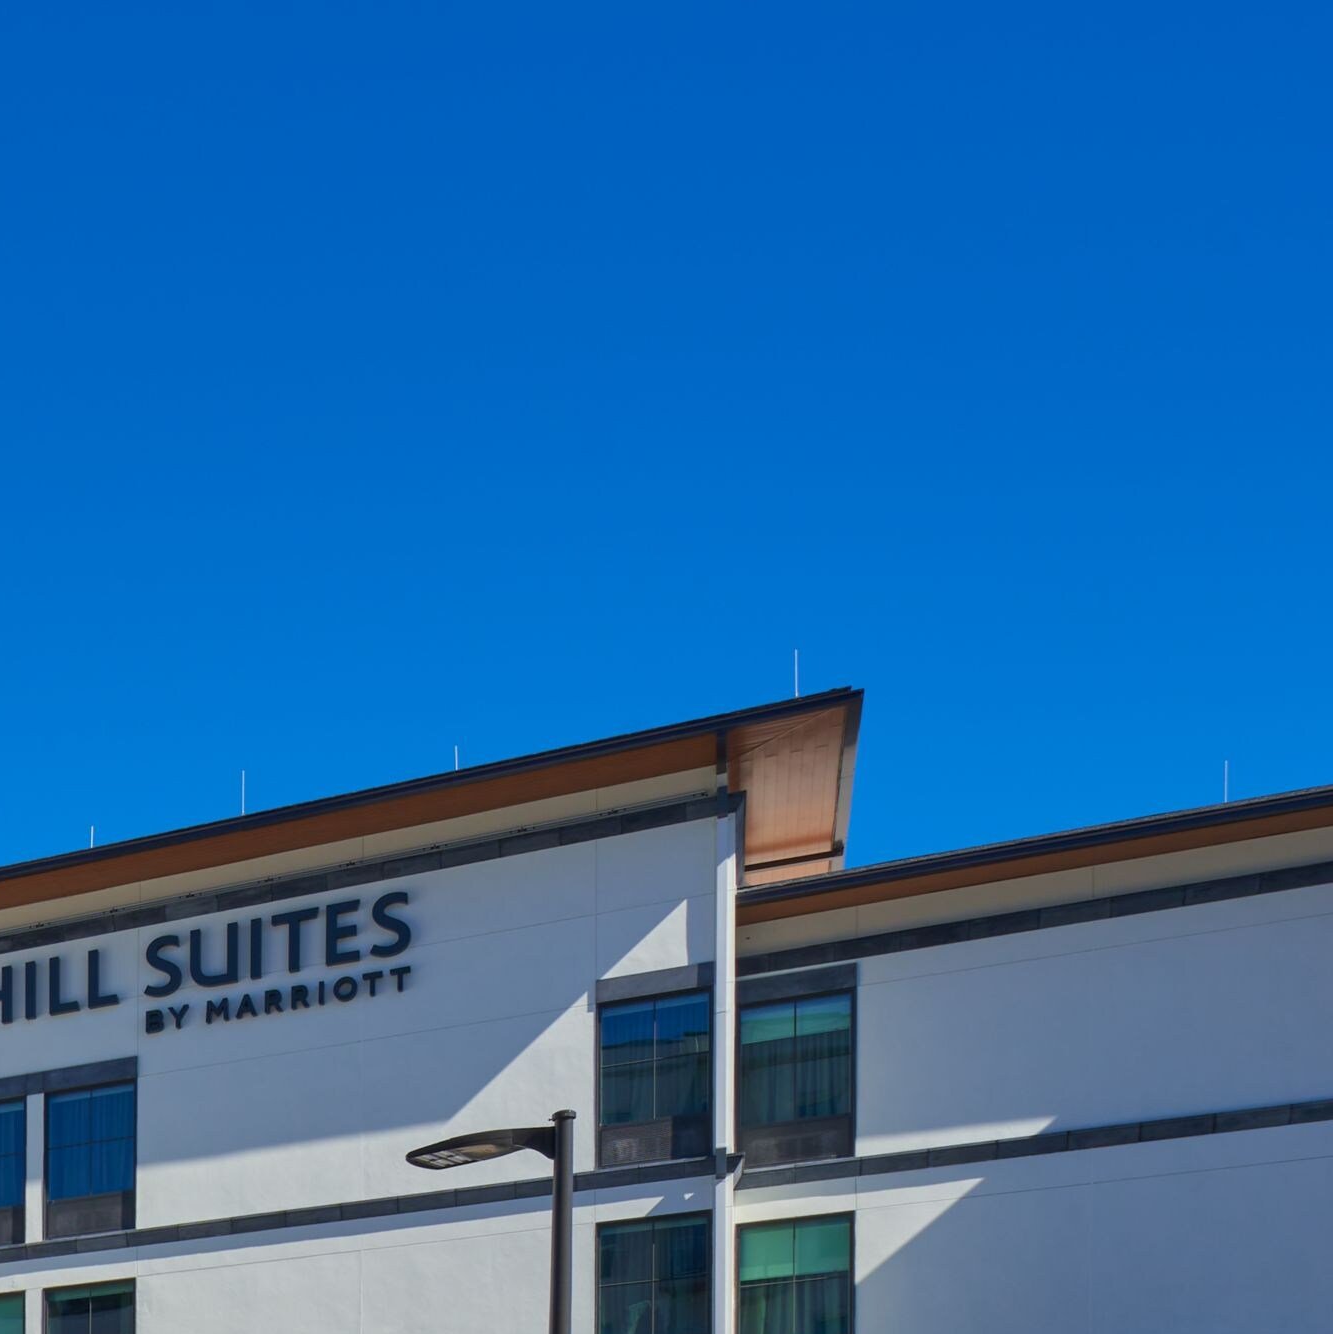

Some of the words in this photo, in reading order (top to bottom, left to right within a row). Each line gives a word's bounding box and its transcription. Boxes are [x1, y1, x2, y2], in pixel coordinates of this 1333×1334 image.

[144, 891, 413, 999] SUITES
[145, 1004, 190, 1034] BY
[206, 965, 413, 1025] MARRIOTT
